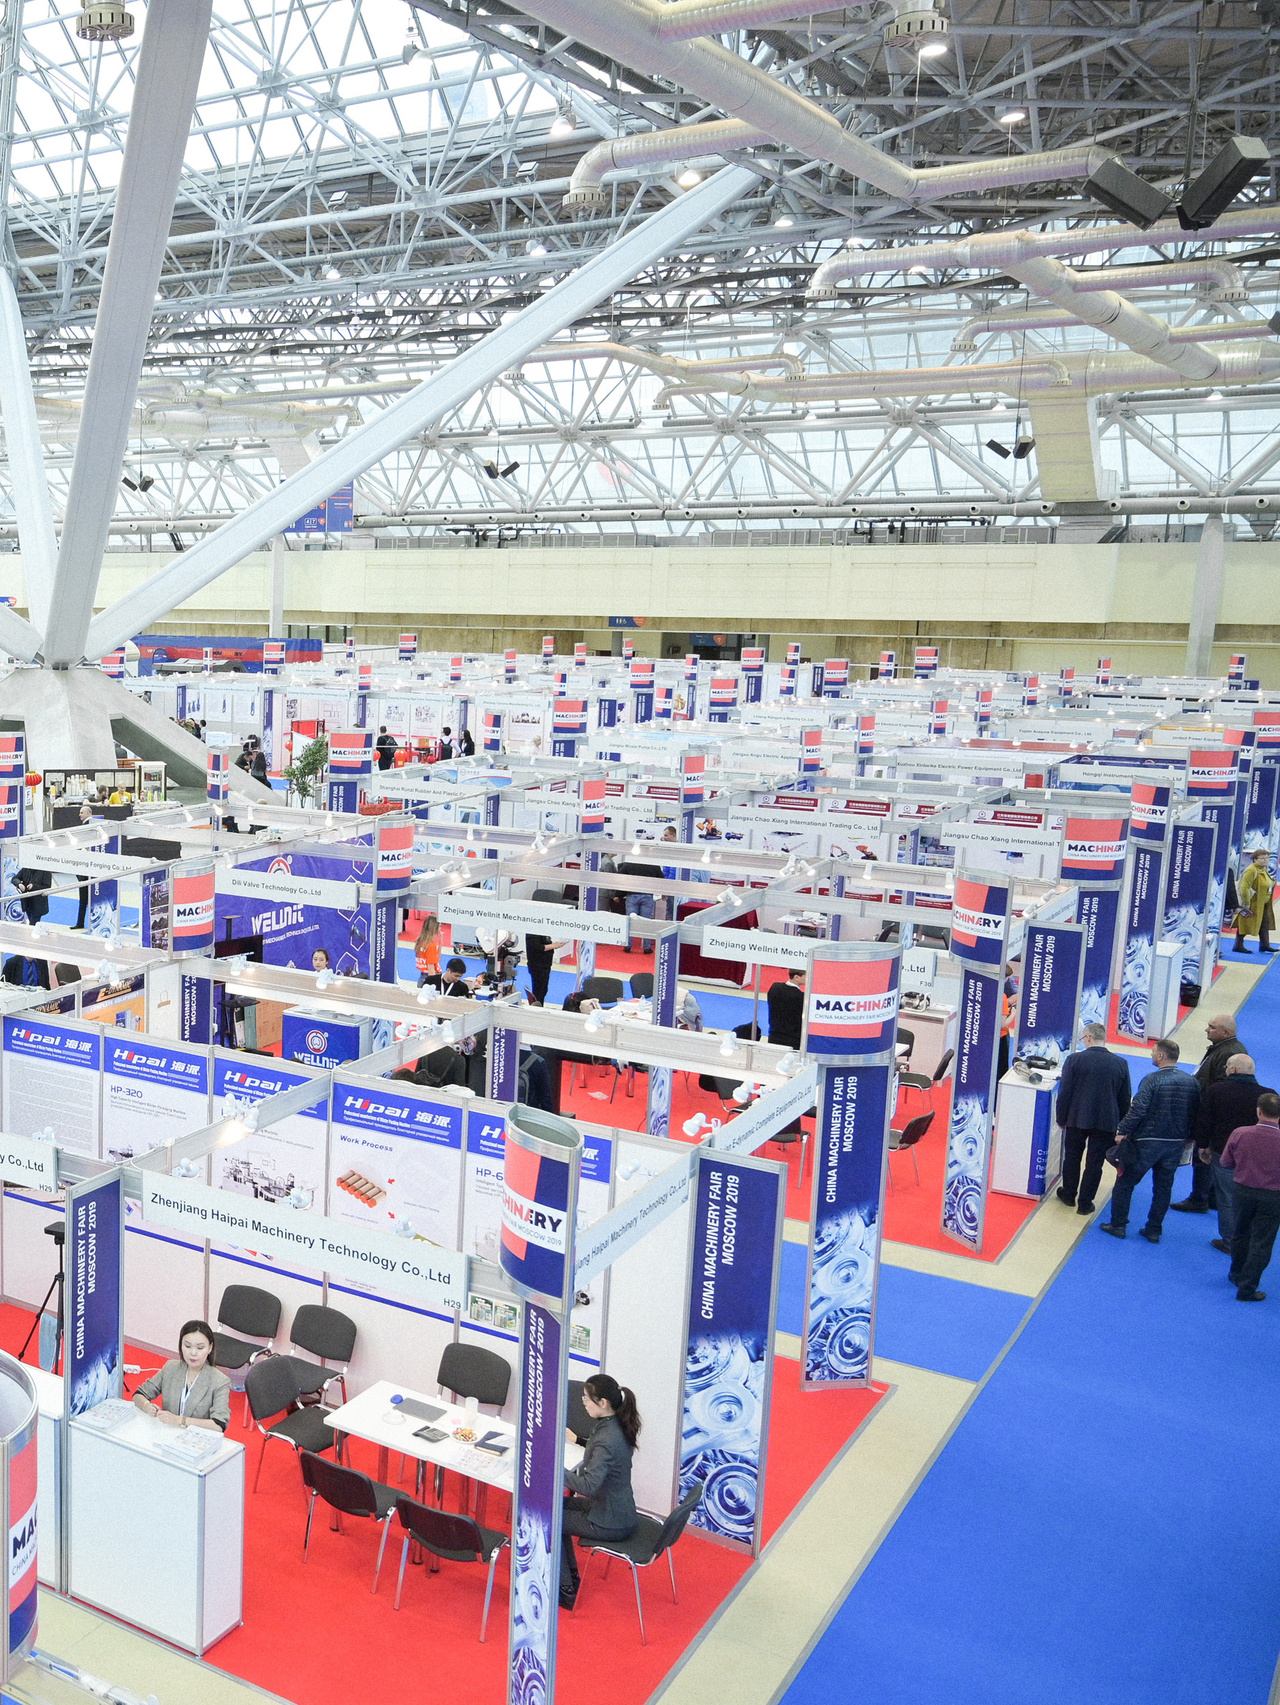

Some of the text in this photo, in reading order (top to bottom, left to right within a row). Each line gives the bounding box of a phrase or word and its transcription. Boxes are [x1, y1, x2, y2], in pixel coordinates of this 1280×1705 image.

[1082, 771, 1101, 779] Hongqi
[730, 815, 753, 824] Jiangsu
[771, 818, 789, 827] Xiang
[790, 819, 828, 829] International
[829, 822, 853, 831] Trading
[1068, 843, 1125, 853] MACHINERY
[61, 858, 89, 867] Lianggong
[90, 862, 111, 870] Forging
[262, 883, 297, 894] Technology
[443, 906, 621, 934] Zhejiang Wellnit Mechanical Technology Co.,Ltd
[816, 995, 896, 1013] MACHINERY
[12, 1028, 61, 1045] Hipai
[114, 1049, 167, 1068] Hipai
[110, 1085, 143, 1099] HP-320
[344, 1096, 410, 1119] Hipai
[843, 1076, 858, 1151] MOSCOW 2019
[340, 1135, 393, 1152] Work Process
[826, 1077, 844, 1203] CHINA MACHINERY FAIR
[8, 1154, 44, 1172] Co.,Ltd
[39, 1183, 53, 1193] H29
[722, 1175, 739, 1265] MOSCOW 2019
[151, 1192, 462, 1310] Zhenjiang Haipai Machinery Technology Co.,Ltd H29
[701, 1171, 722, 1319] CHINA MACHINERY FAIR
